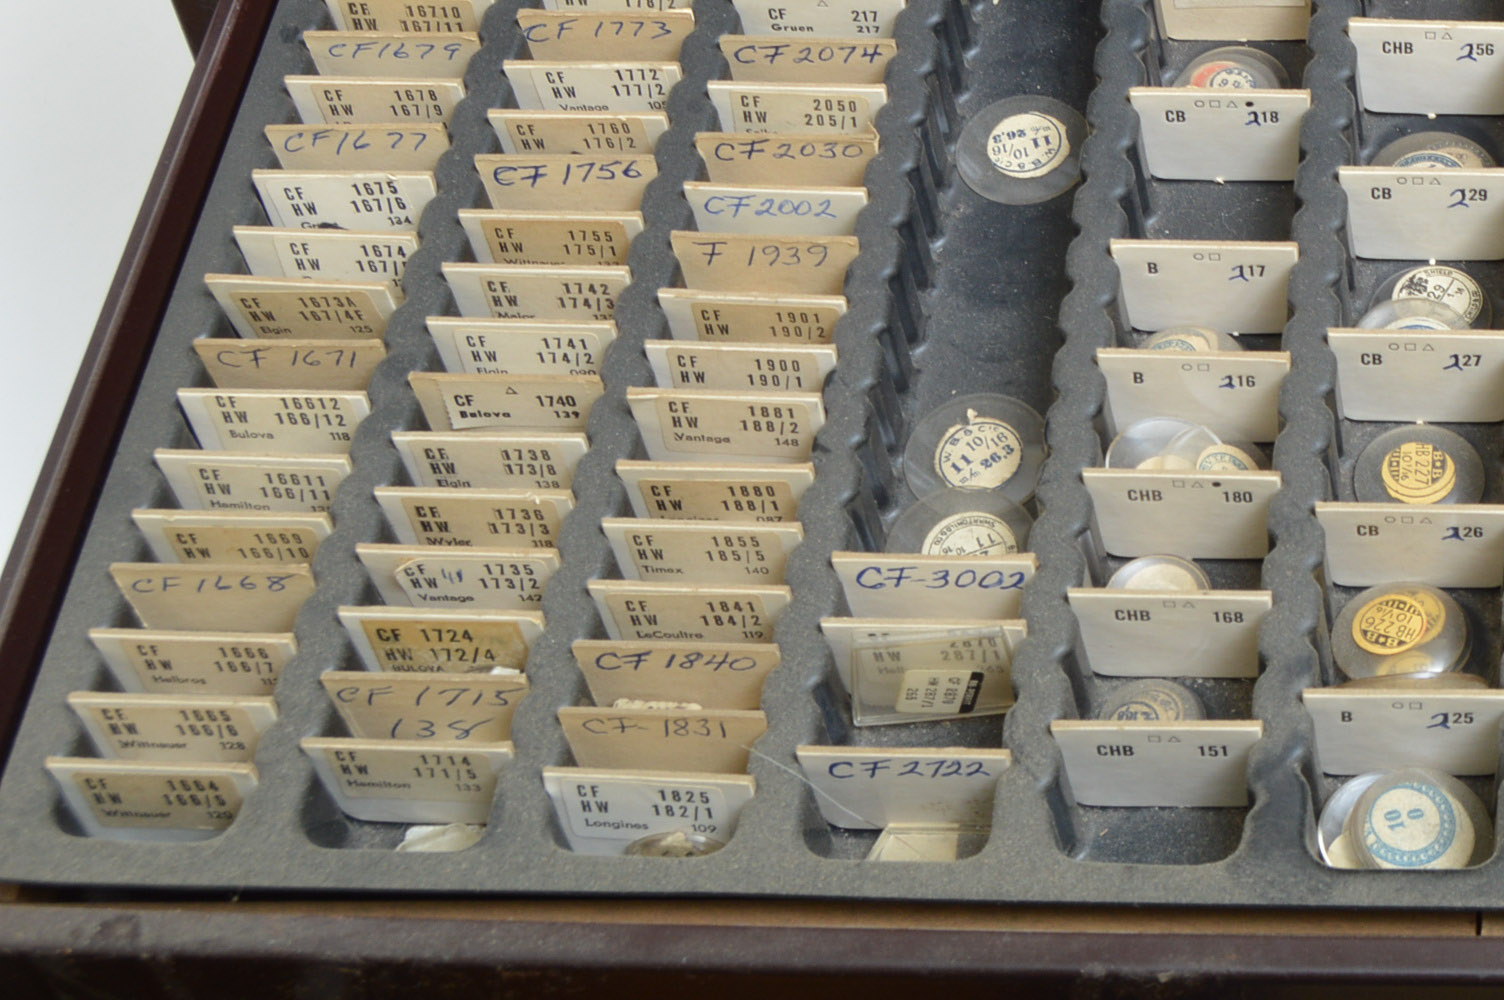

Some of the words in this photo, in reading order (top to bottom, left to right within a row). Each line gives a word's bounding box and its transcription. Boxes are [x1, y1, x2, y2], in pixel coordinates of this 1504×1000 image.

[768, 9, 786, 20] CF
[851, 10, 878, 22] 217
[595, 21, 672, 38] 1773
[772, 24, 814, 32] Gruen
[1382, 42, 1413, 54] CHB
[546, 72, 565, 84] CF
[615, 69, 659, 81] 1772
[324, 90, 344, 101] CF
[394, 90, 439, 101] 1678
[741, 96, 760, 108] CF
[814, 99, 857, 111] 2050
[1165, 110, 1186, 122] CB
[516, 125, 536, 135] CF
[588, 123, 630, 135] 1760
[562, 162, 642, 185] 1756
[284, 188, 304, 200] CF
[351, 182, 399, 197] 1675
[1371, 187, 1392, 200] CB
[291, 202, 317, 215] HW
[568, 231, 613, 243] 1755
[1147, 263, 1159, 274] B
[776, 312, 821, 323] 1901
[466, 336, 486, 347] CF
[542, 338, 588, 350] 1741
[755, 359, 800, 372] 1900
[1360, 354, 1382, 365] CB
[1133, 372, 1144, 383] B
[454, 395, 473, 407] CF
[536, 395, 577, 407] 1740
[460, 410, 511, 418] Bulova
[749, 405, 794, 419] 1881
[1127, 490, 1163, 501] CHB
[1222, 491, 1253, 503] 180
[1356, 525, 1379, 536] CB
[483, 564, 534, 575] 1735
[1114, 610, 1151, 621] CHB
[1213, 612, 1243, 623] 168
[376, 628, 402, 642] CF
[420, 628, 473, 642] 1724
[1341, 711, 1352, 722] B
[1096, 745, 1134, 756] CHB
[1197, 745, 1228, 757] 151
[577, 785, 600, 798] CF
[658, 789, 710, 804] 1825
[581, 800, 609, 814] HW
